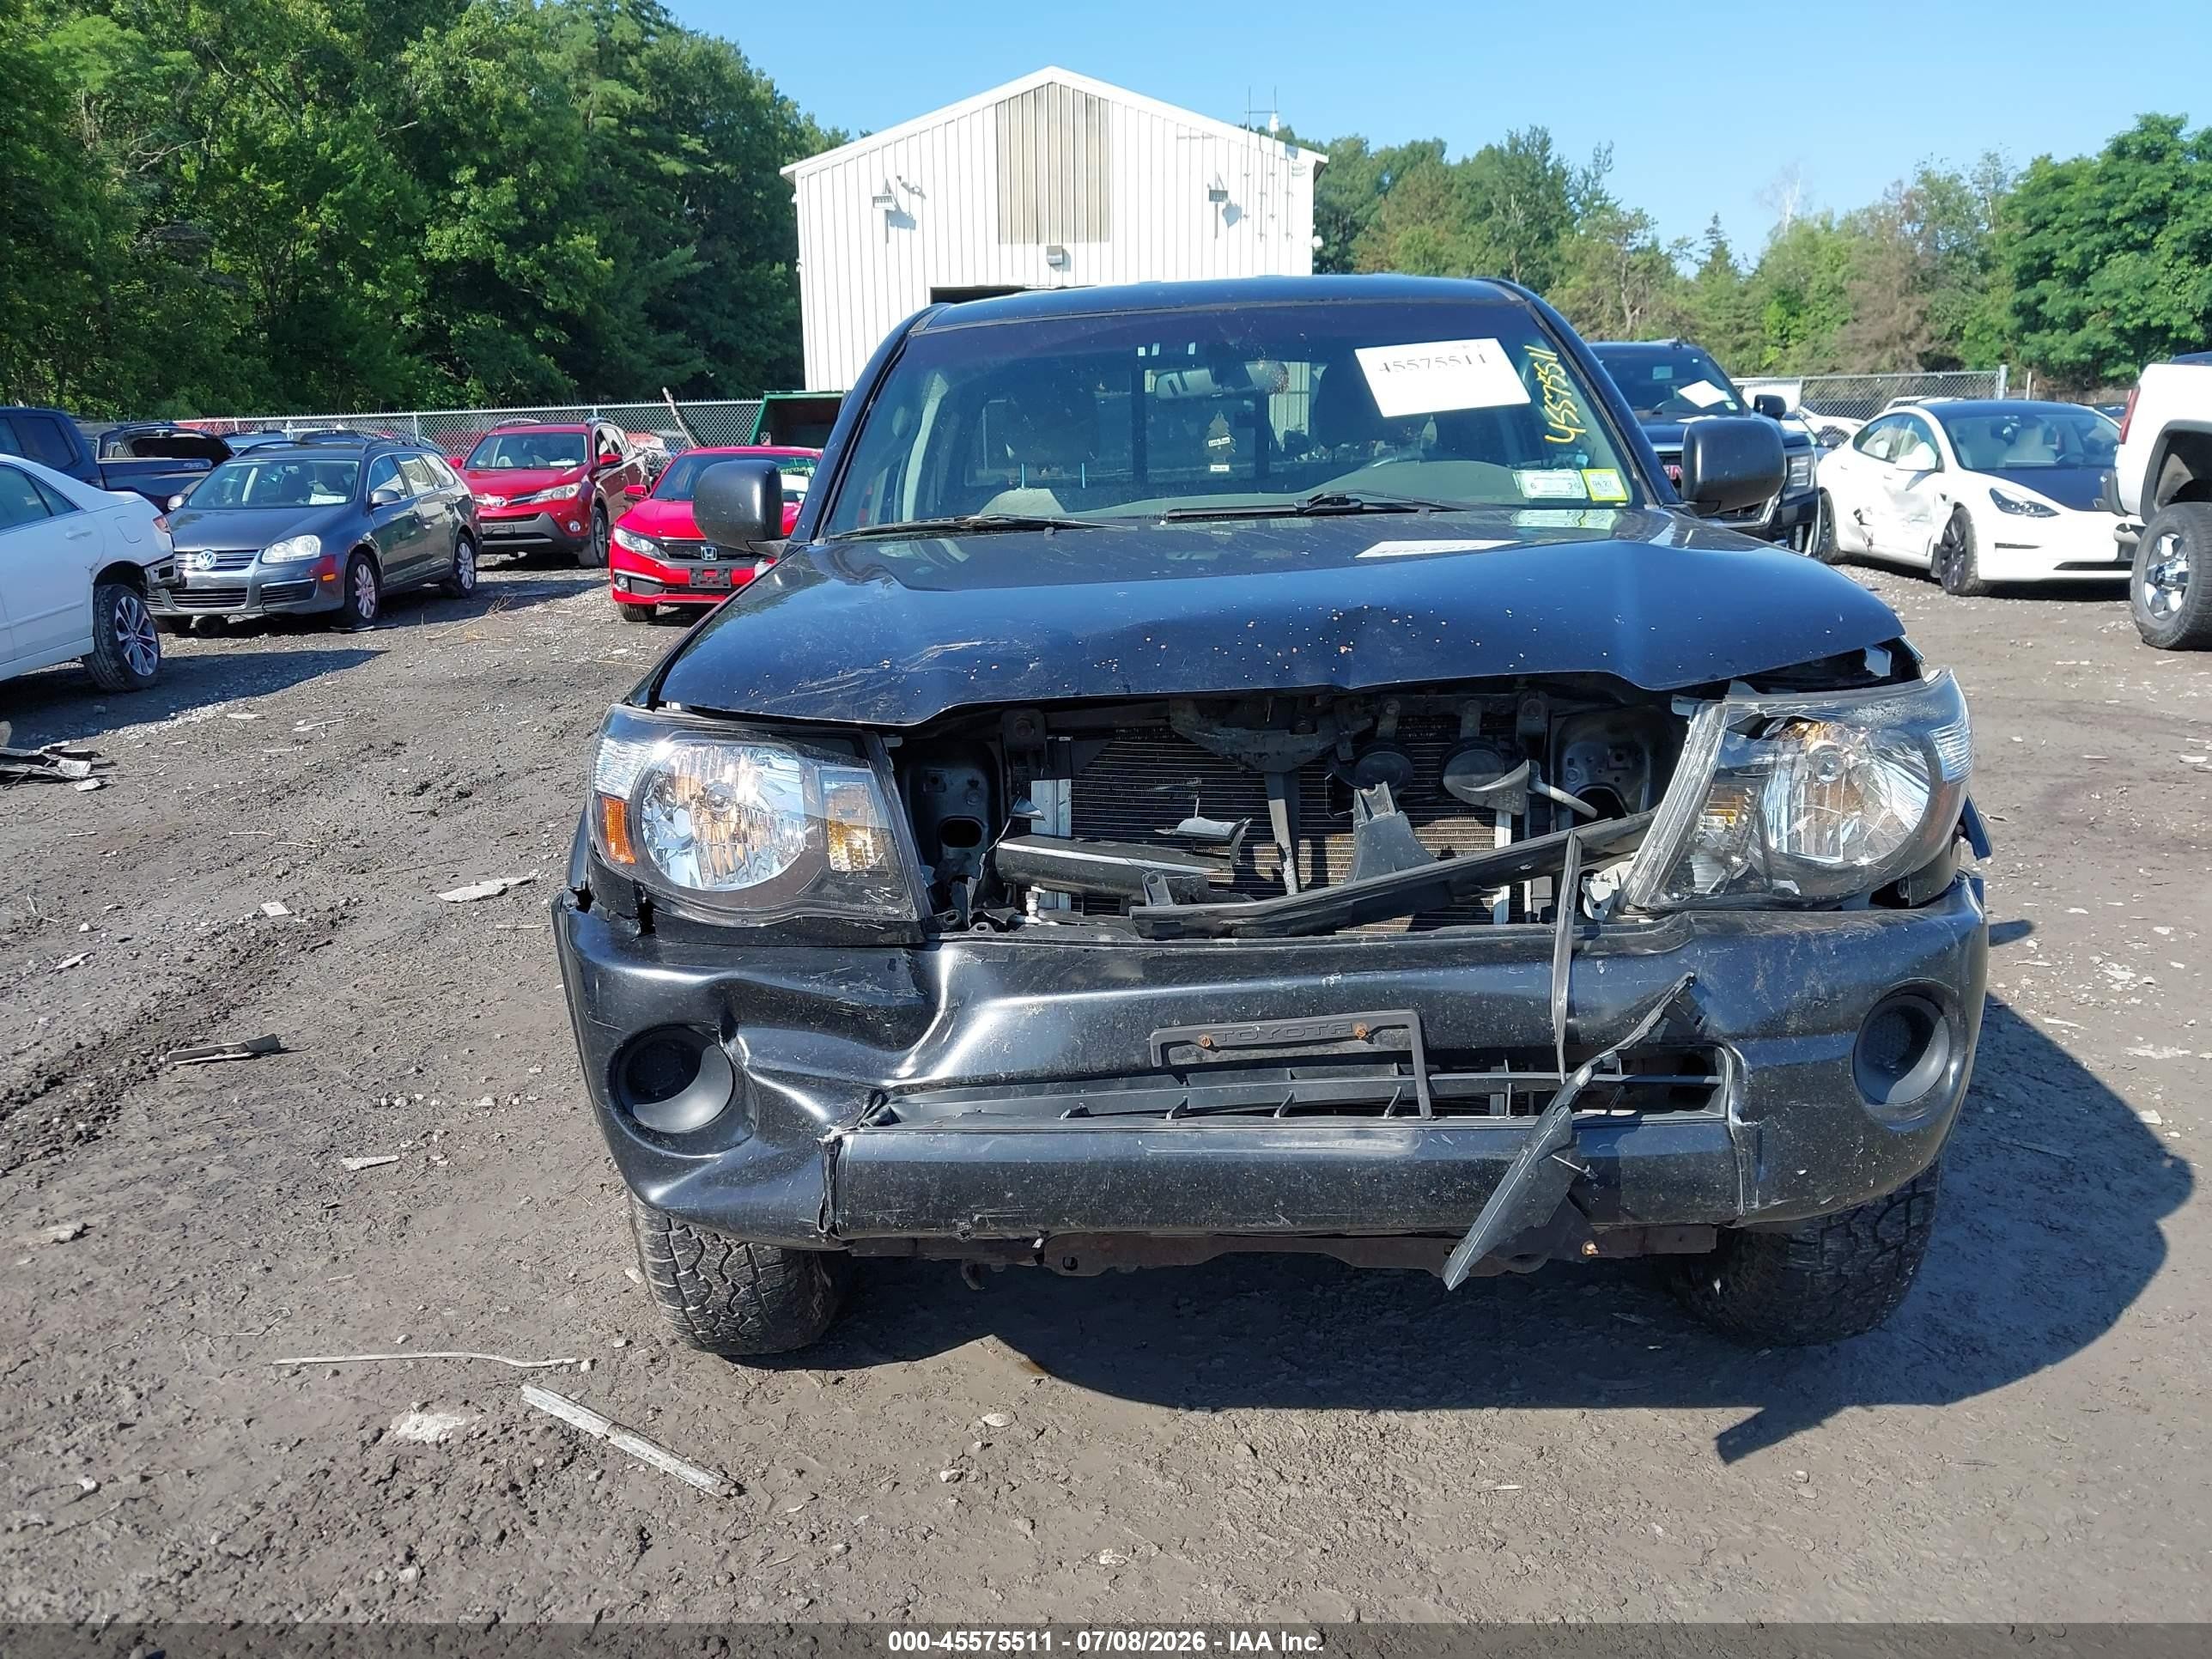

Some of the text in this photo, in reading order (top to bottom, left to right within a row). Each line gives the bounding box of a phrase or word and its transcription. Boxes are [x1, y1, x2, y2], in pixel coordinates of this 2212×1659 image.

[1378, 353, 1487, 373] 45575511
[1523, 345, 1587, 443] 45575511
[1212, 1023, 1353, 1042] TOYOTA
